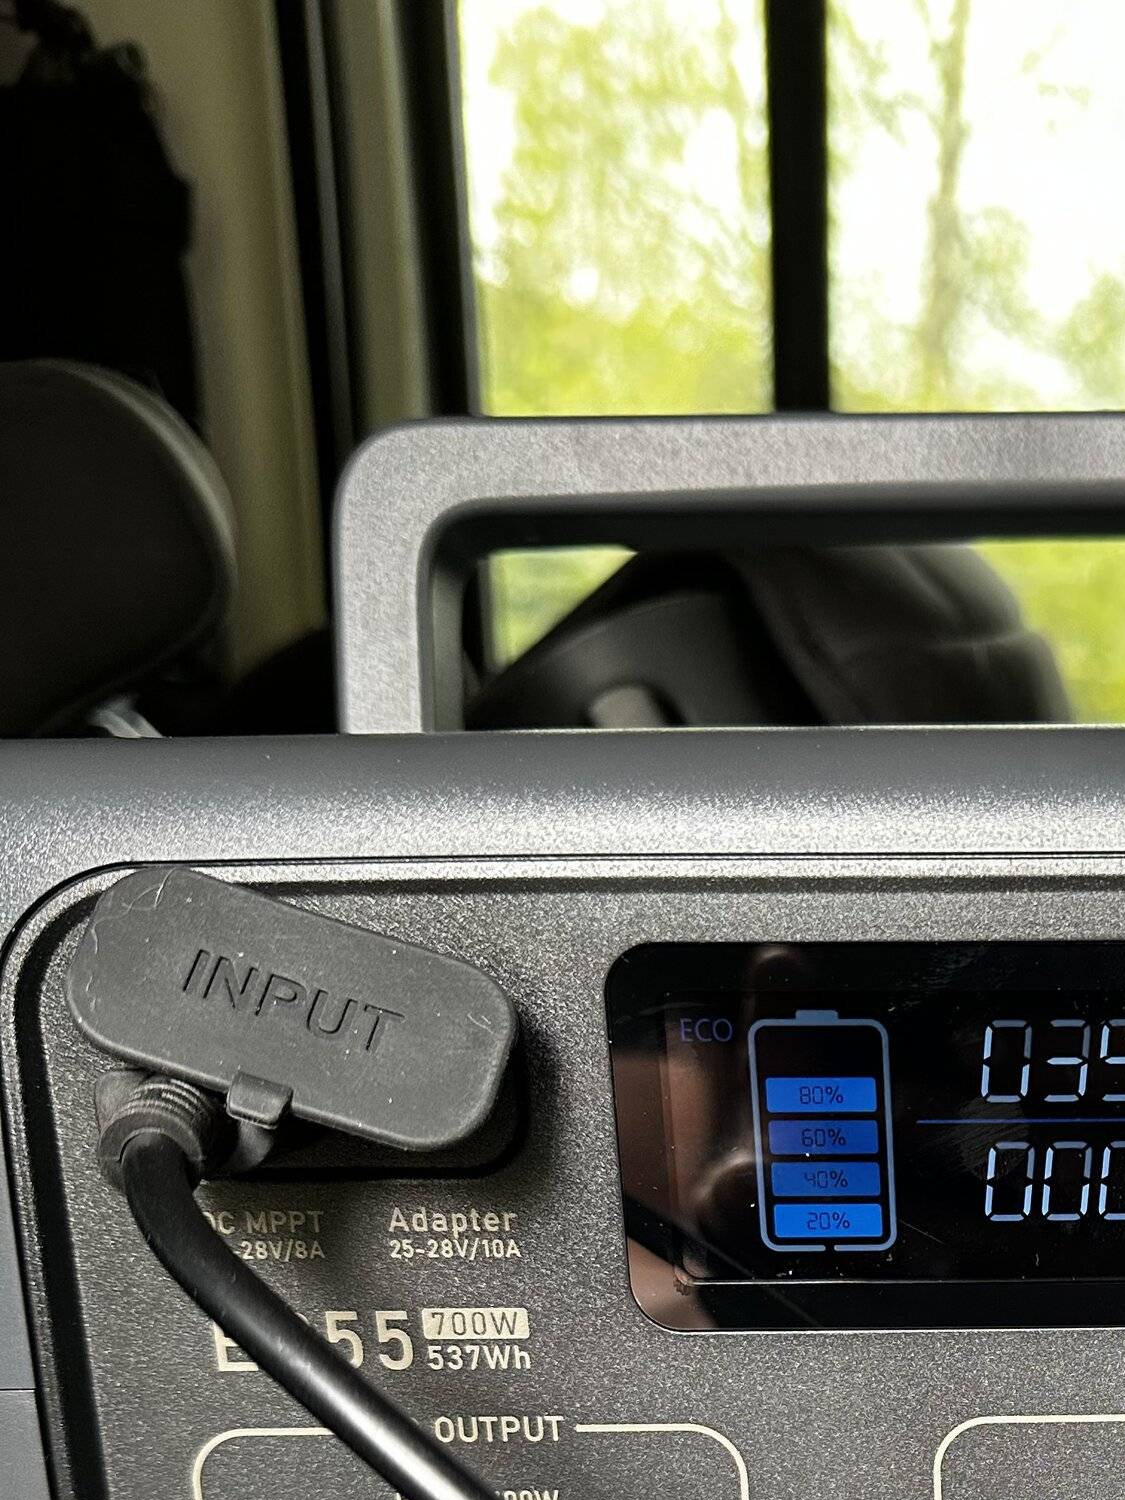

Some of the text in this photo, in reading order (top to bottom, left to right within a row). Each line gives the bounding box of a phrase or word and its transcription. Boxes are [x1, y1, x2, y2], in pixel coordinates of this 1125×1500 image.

[181, 949, 405, 1052] INPUT
[679, 1018, 733, 1043] ECO
[799, 1085, 845, 1105] 80%
[801, 1127, 847, 1148] 60%
[803, 1169, 849, 1189] 40%
[243, 1209, 325, 1234] MPPT
[388, 1206, 517, 1239] Adapter
[806, 1211, 851, 1231] 20%
[232, 1238, 326, 1263] -28V/8A
[388, 1237, 522, 1263] 25-28V/10A
[431, 1311, 519, 1337] 700W
[213, 1310, 415, 1373] E55
[427, 1345, 532, 1371] 537Wh
[434, 1415, 565, 1443] OUTPUT
